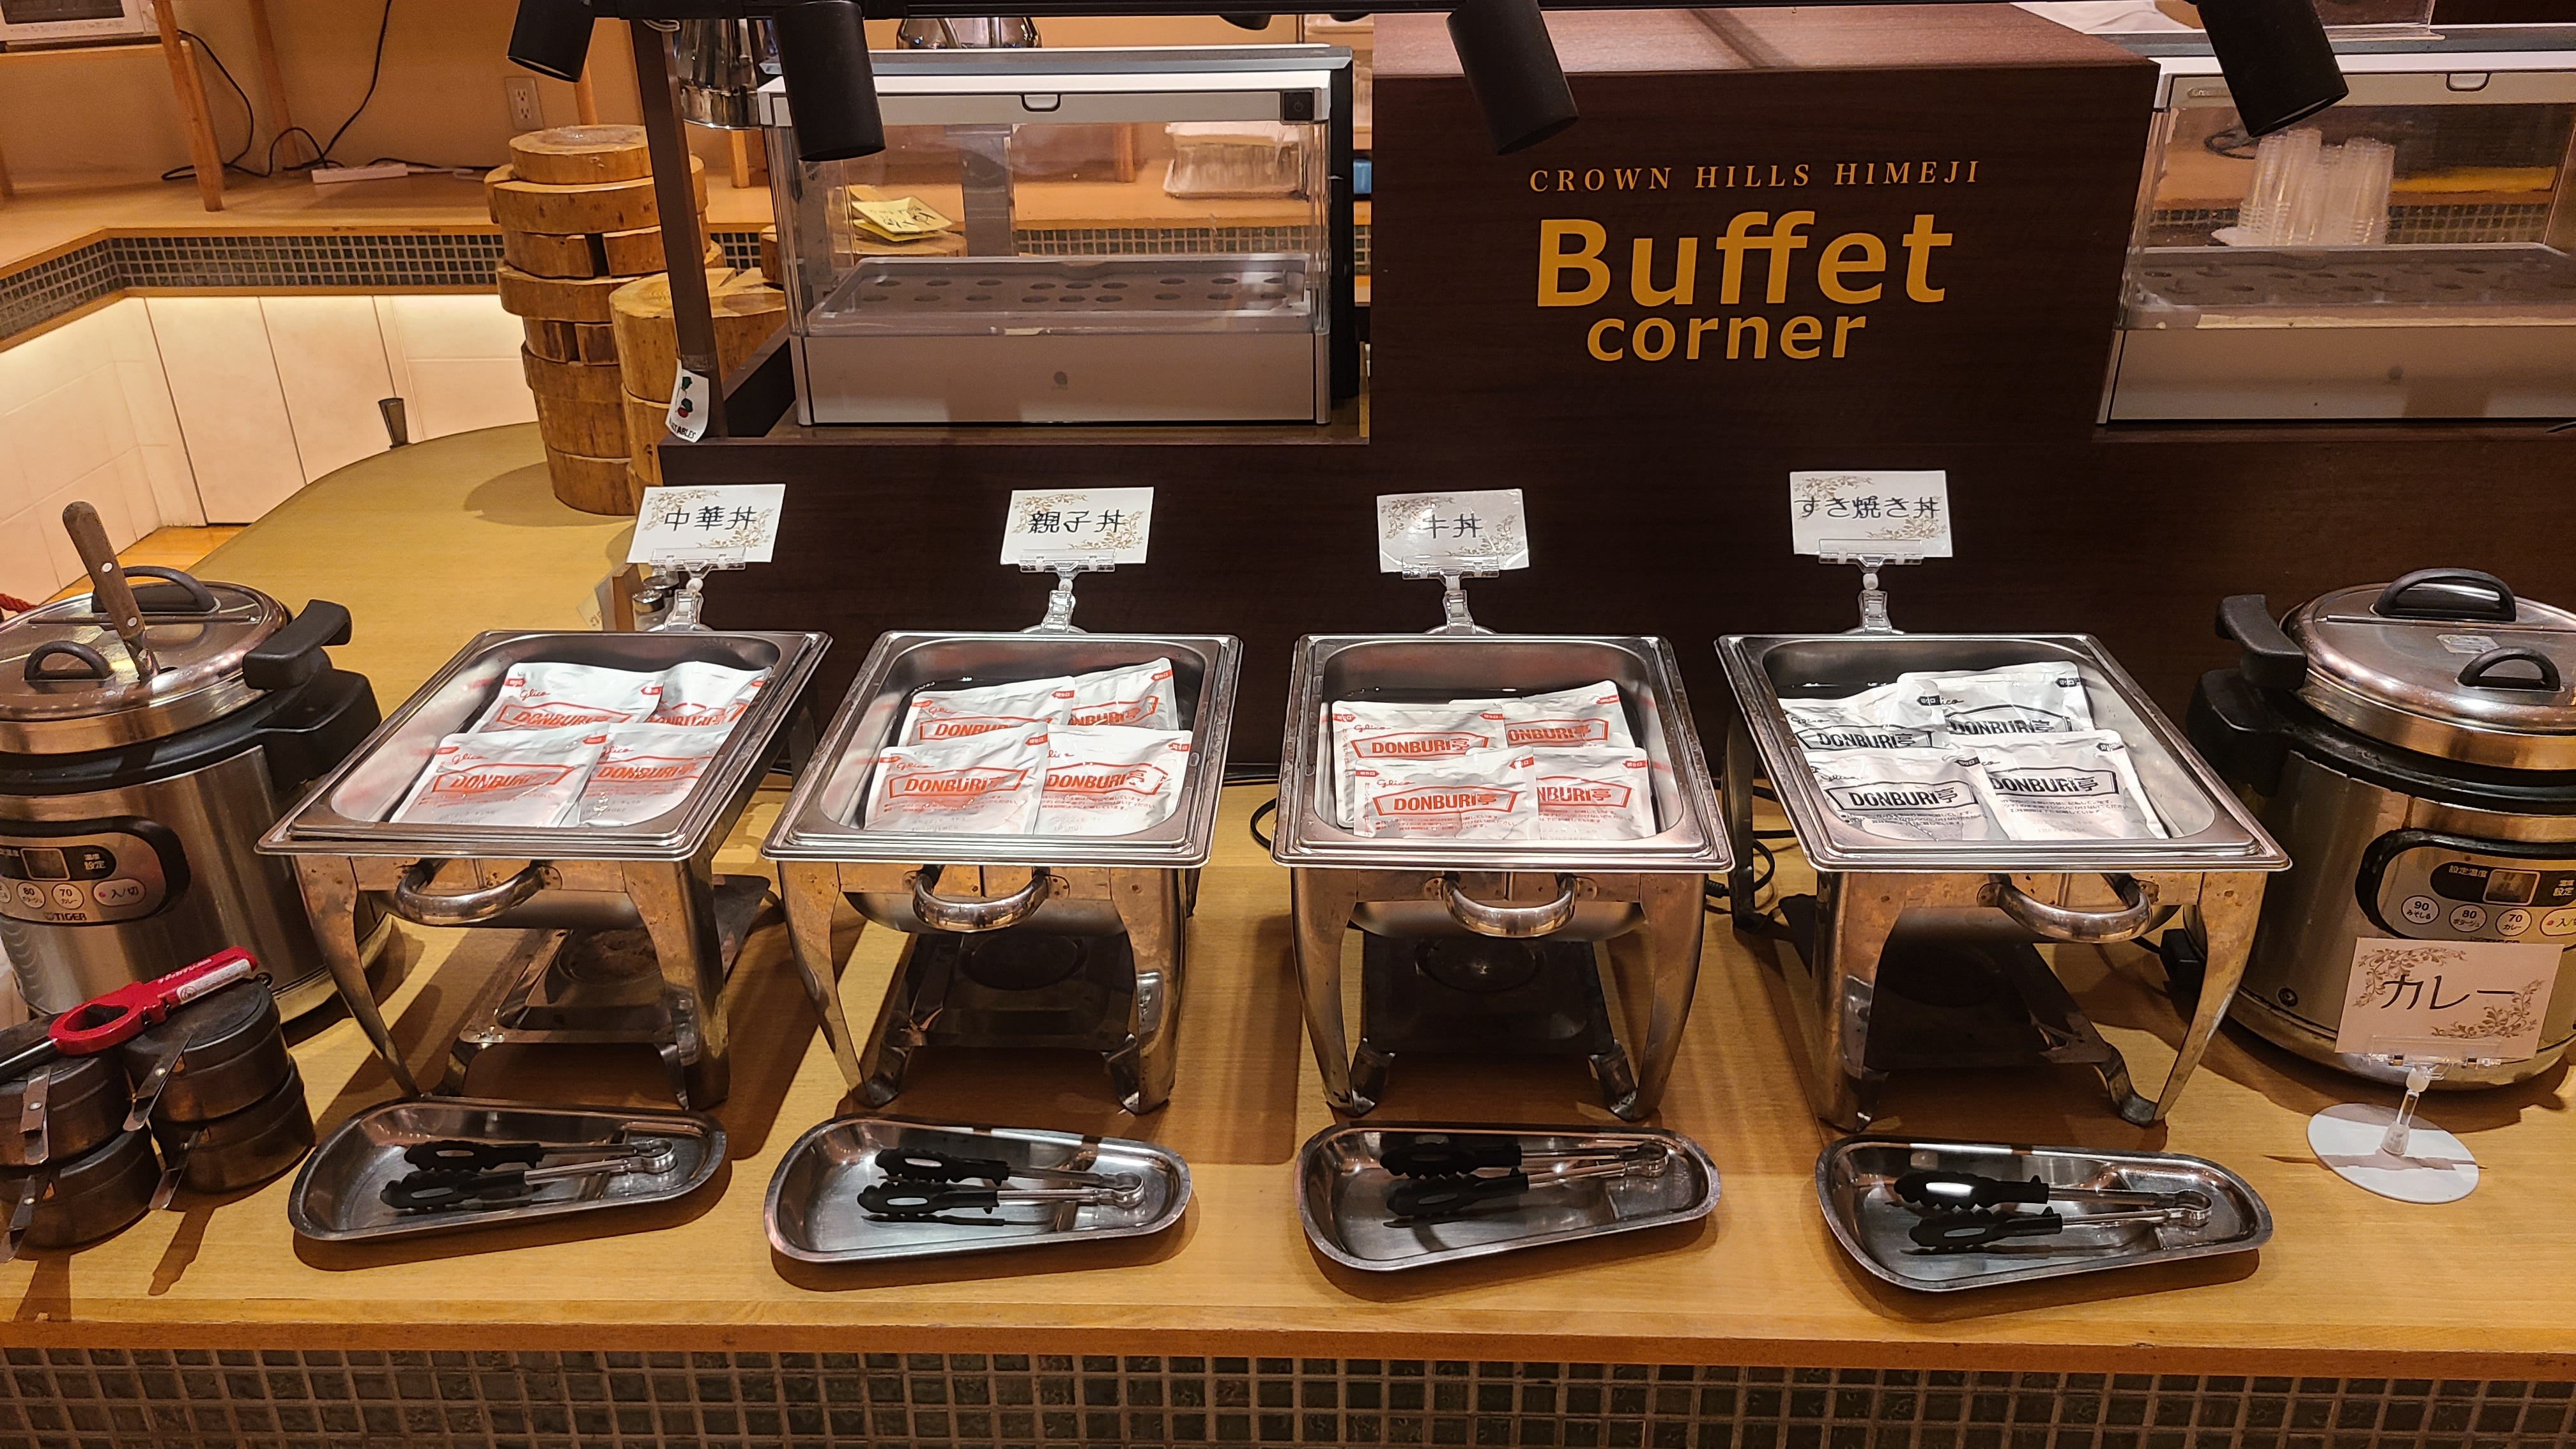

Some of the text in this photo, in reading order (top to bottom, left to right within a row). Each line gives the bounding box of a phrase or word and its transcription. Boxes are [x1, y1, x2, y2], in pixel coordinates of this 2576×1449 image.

[1530, 160, 1980, 192] CROWN HILLS HIMEJI
[1537, 210, 1953, 307] Buffet
[1587, 315, 1866, 362] corner
[1793, 495, 1941, 519] すき焼き丼
[664, 505, 758, 532] 中華丼
[1027, 509, 1129, 534] 親子丼
[23, 887, 35, 896] 80
[59, 889, 73, 897] 70
[2407, 909, 2431, 920] みそしる
[2414, 901, 2430, 911] 90
[2462, 910, 2478, 919] 80
[54, 912, 88, 921] TIGER
[2508, 914, 2523, 923] 70
[2380, 974, 2516, 1011] カレー
